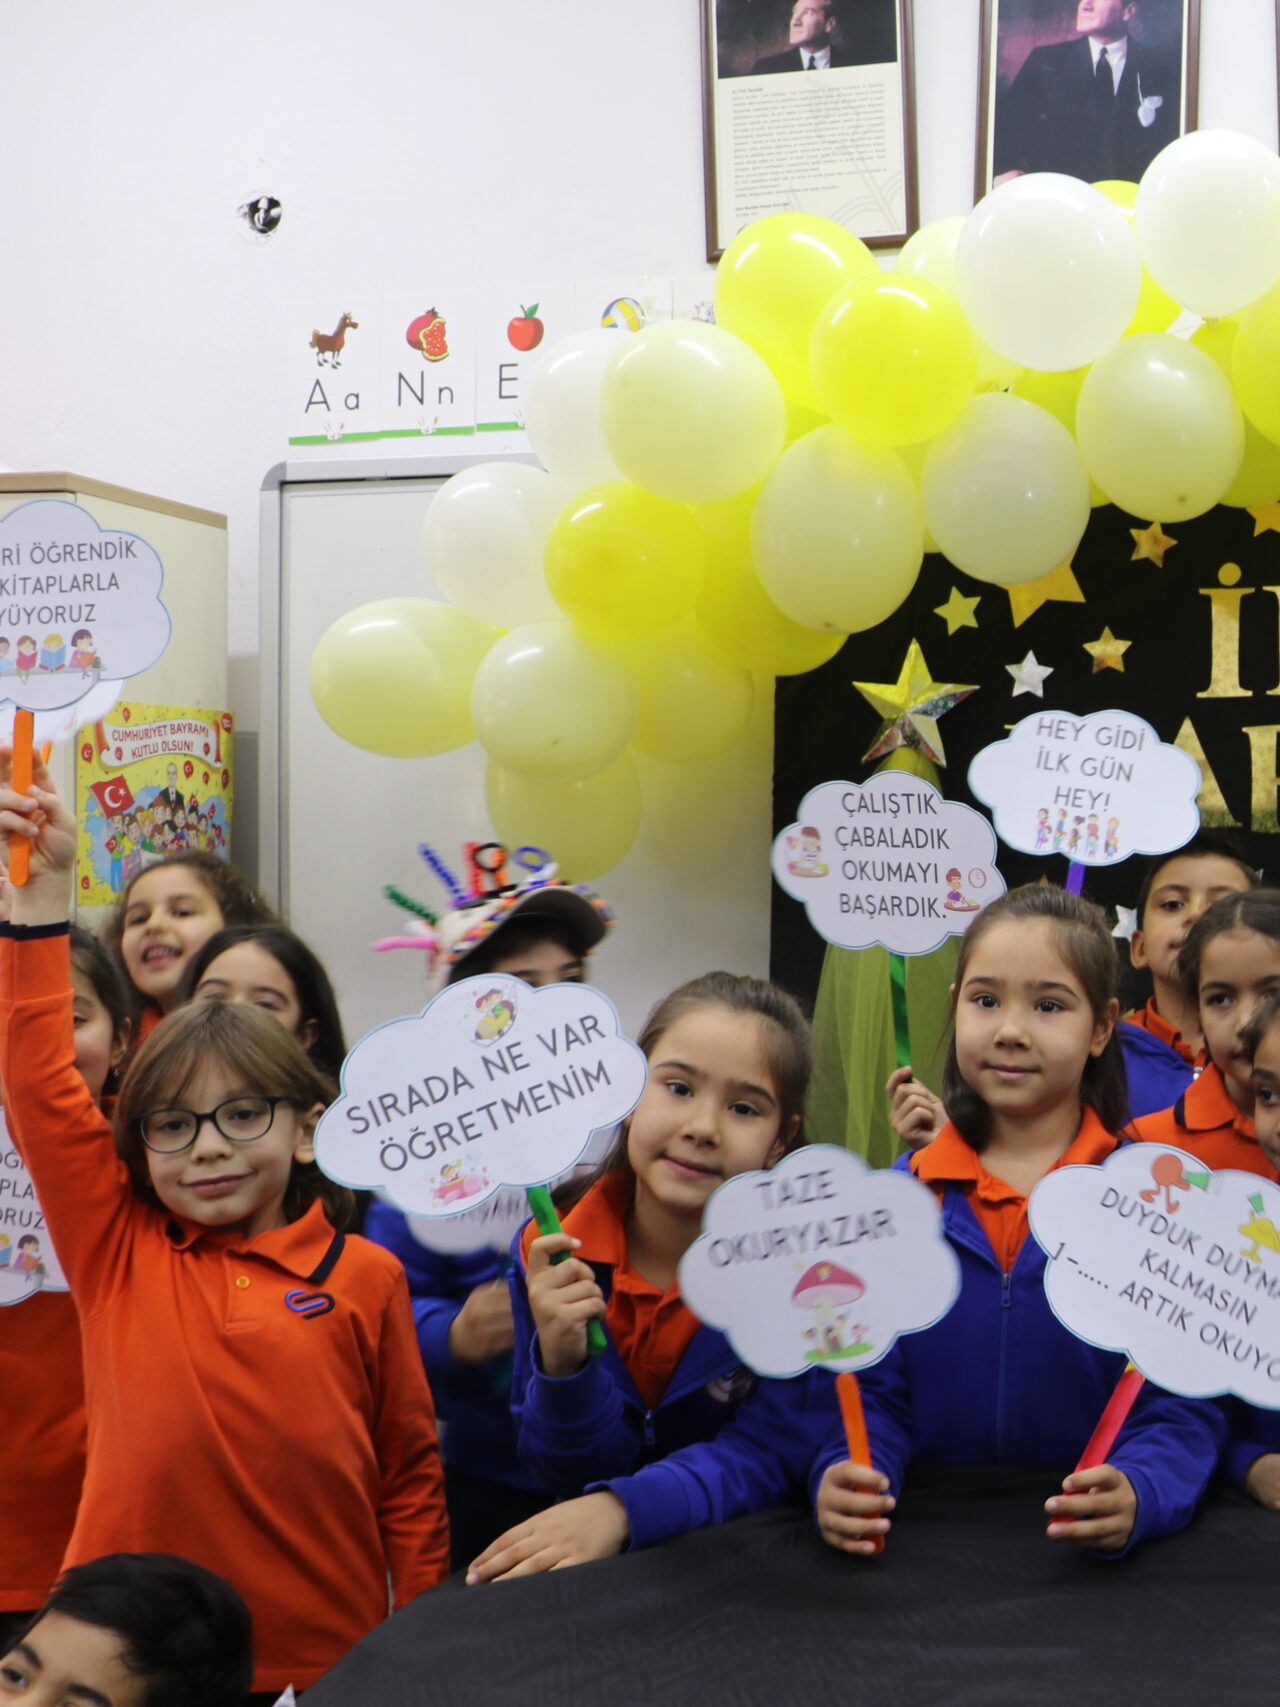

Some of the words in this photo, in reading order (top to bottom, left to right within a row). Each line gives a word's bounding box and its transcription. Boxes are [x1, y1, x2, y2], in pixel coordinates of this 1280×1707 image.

[30, 537, 138, 565] ÖĞRENDİK
[0, 572, 120, 597] KİTAPLARLA
[169, 723, 209, 738] BAYRAMI
[1036, 717, 1087, 742] HEY
[1095, 724, 1147, 752] GİDİ
[131, 741, 159, 760] KUTLU
[161, 740, 194, 753] OLSUN!
[1035, 746, 1071, 773] İLK
[1080, 756, 1134, 783] GÜN
[841, 792, 938, 819] ÇALIŞTIK
[1053, 786, 1111, 812] HEY!
[835, 826, 950, 851] ÇABALADIK
[841, 860, 939, 884] OKUMAYI
[839, 893, 947, 920] BAŞARDIK.
[346, 1067, 475, 1135] SIRADA
[481, 1041, 531, 1082] NE
[536, 1014, 606, 1057] VAR
[379, 1060, 612, 1171] ÖĞRETMENİM
[754, 1168, 838, 1212] TAZE
[0, 1206, 45, 1230] RUZ
[1100, 1187, 1203, 1256] DUYDUK
[708, 1208, 899, 1268] OKURYAZAR
[1139, 1248, 1259, 1326] KALMASIN
[1119, 1280, 1195, 1333] ARTIK
